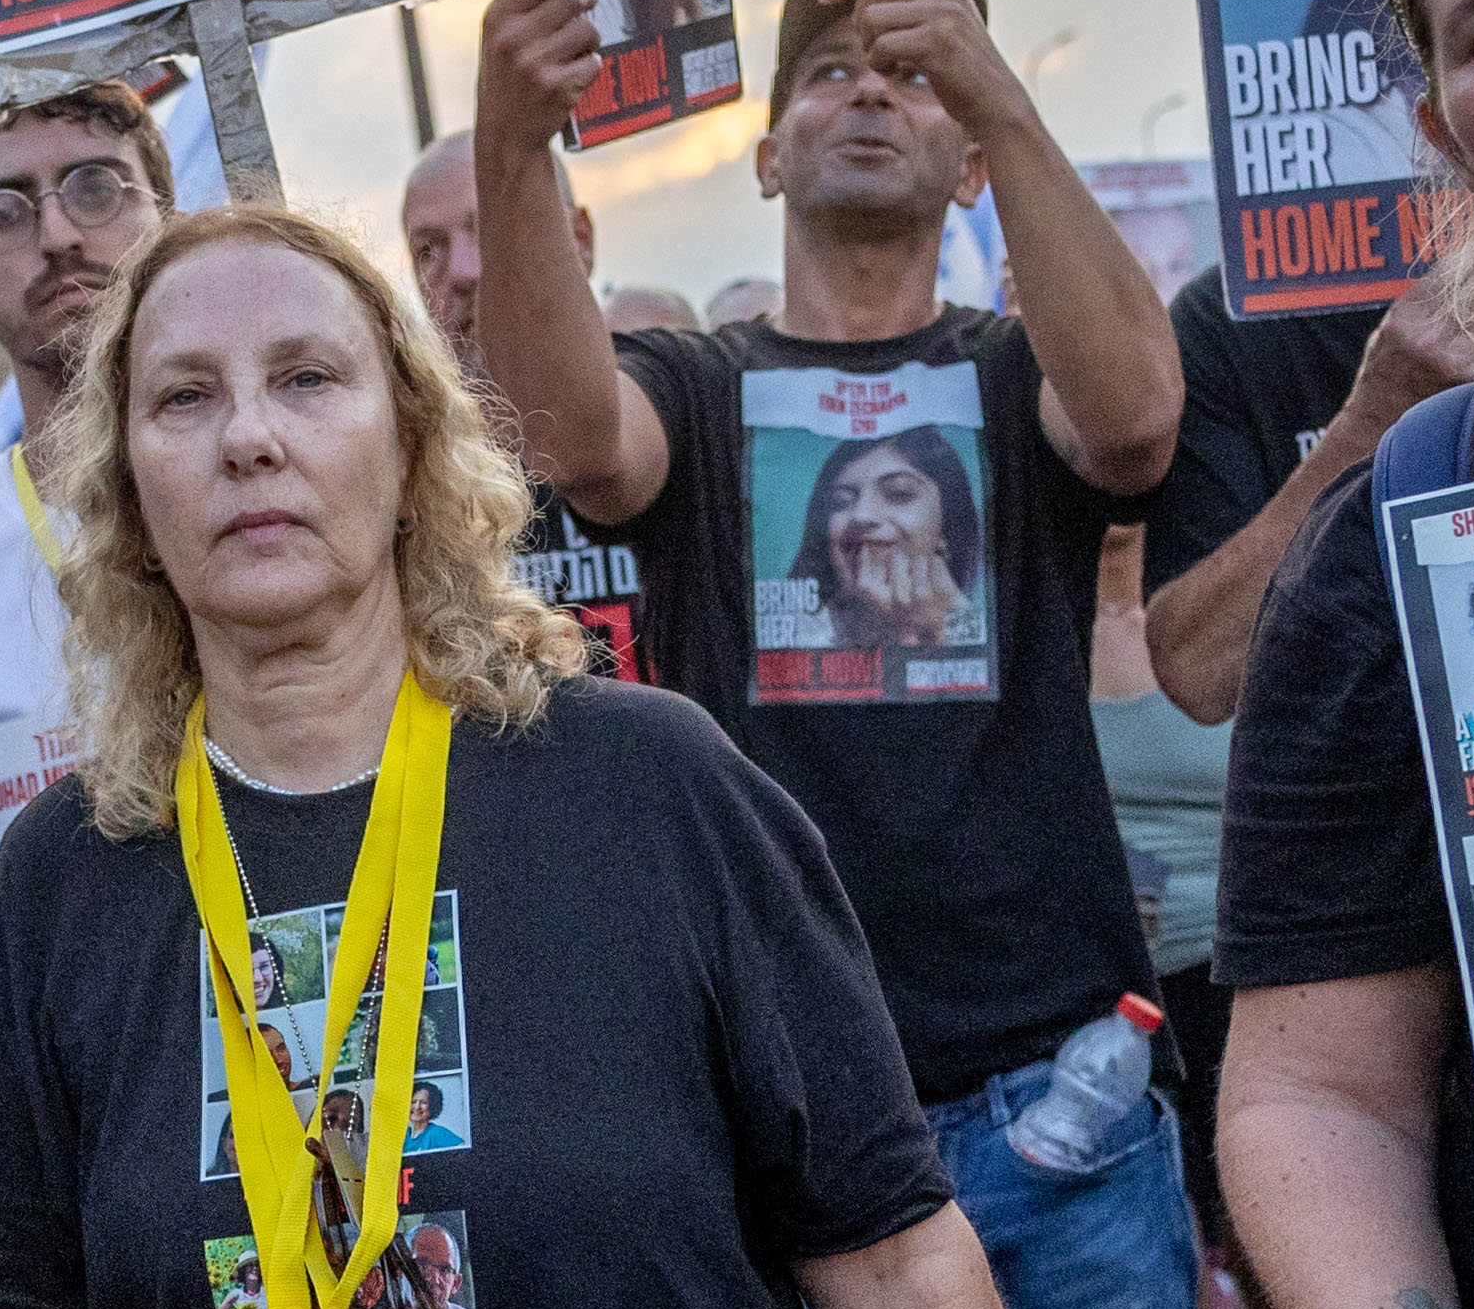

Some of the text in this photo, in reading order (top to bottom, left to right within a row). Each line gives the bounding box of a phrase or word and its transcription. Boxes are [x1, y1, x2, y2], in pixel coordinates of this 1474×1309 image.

[1223, 29, 1381, 119] BRING
[1231, 113, 1335, 197] HER
[1240, 196, 1386, 280] HOME
